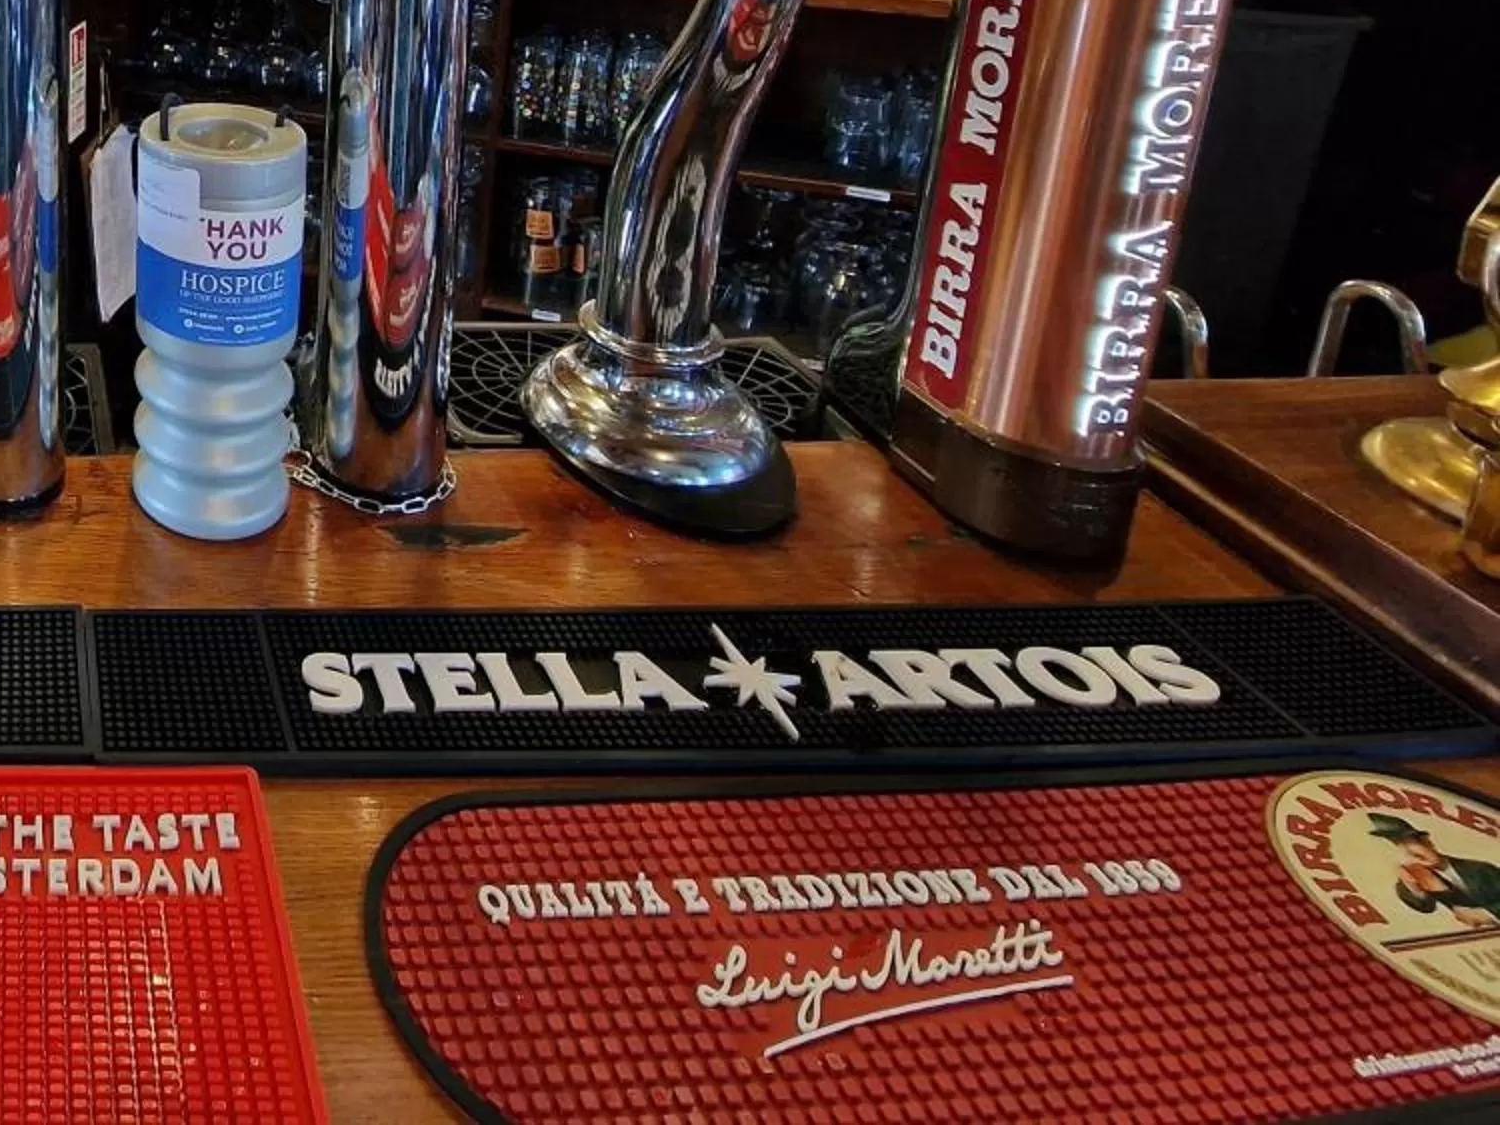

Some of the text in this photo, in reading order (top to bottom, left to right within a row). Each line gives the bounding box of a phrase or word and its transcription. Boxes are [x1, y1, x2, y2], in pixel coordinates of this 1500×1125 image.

[180, 267, 286, 296] HOSPICE
[207, 241, 268, 262] YOU
[920, 183, 987, 379] BIRRA
[1073, 220, 1173, 438] BIRRA
[301, 644, 1221, 715] STELLA ARTOIS
[93, 812, 241, 852] TASTE
[1285, 797, 1389, 927] BIRRA
[677, 881, 710, 914] E
[715, 868, 993, 915] TRADIZIONE
[988, 864, 1091, 901] DAL
[1082, 857, 1184, 897] 1859
[696, 918, 1064, 1033] Luigi Moretti
